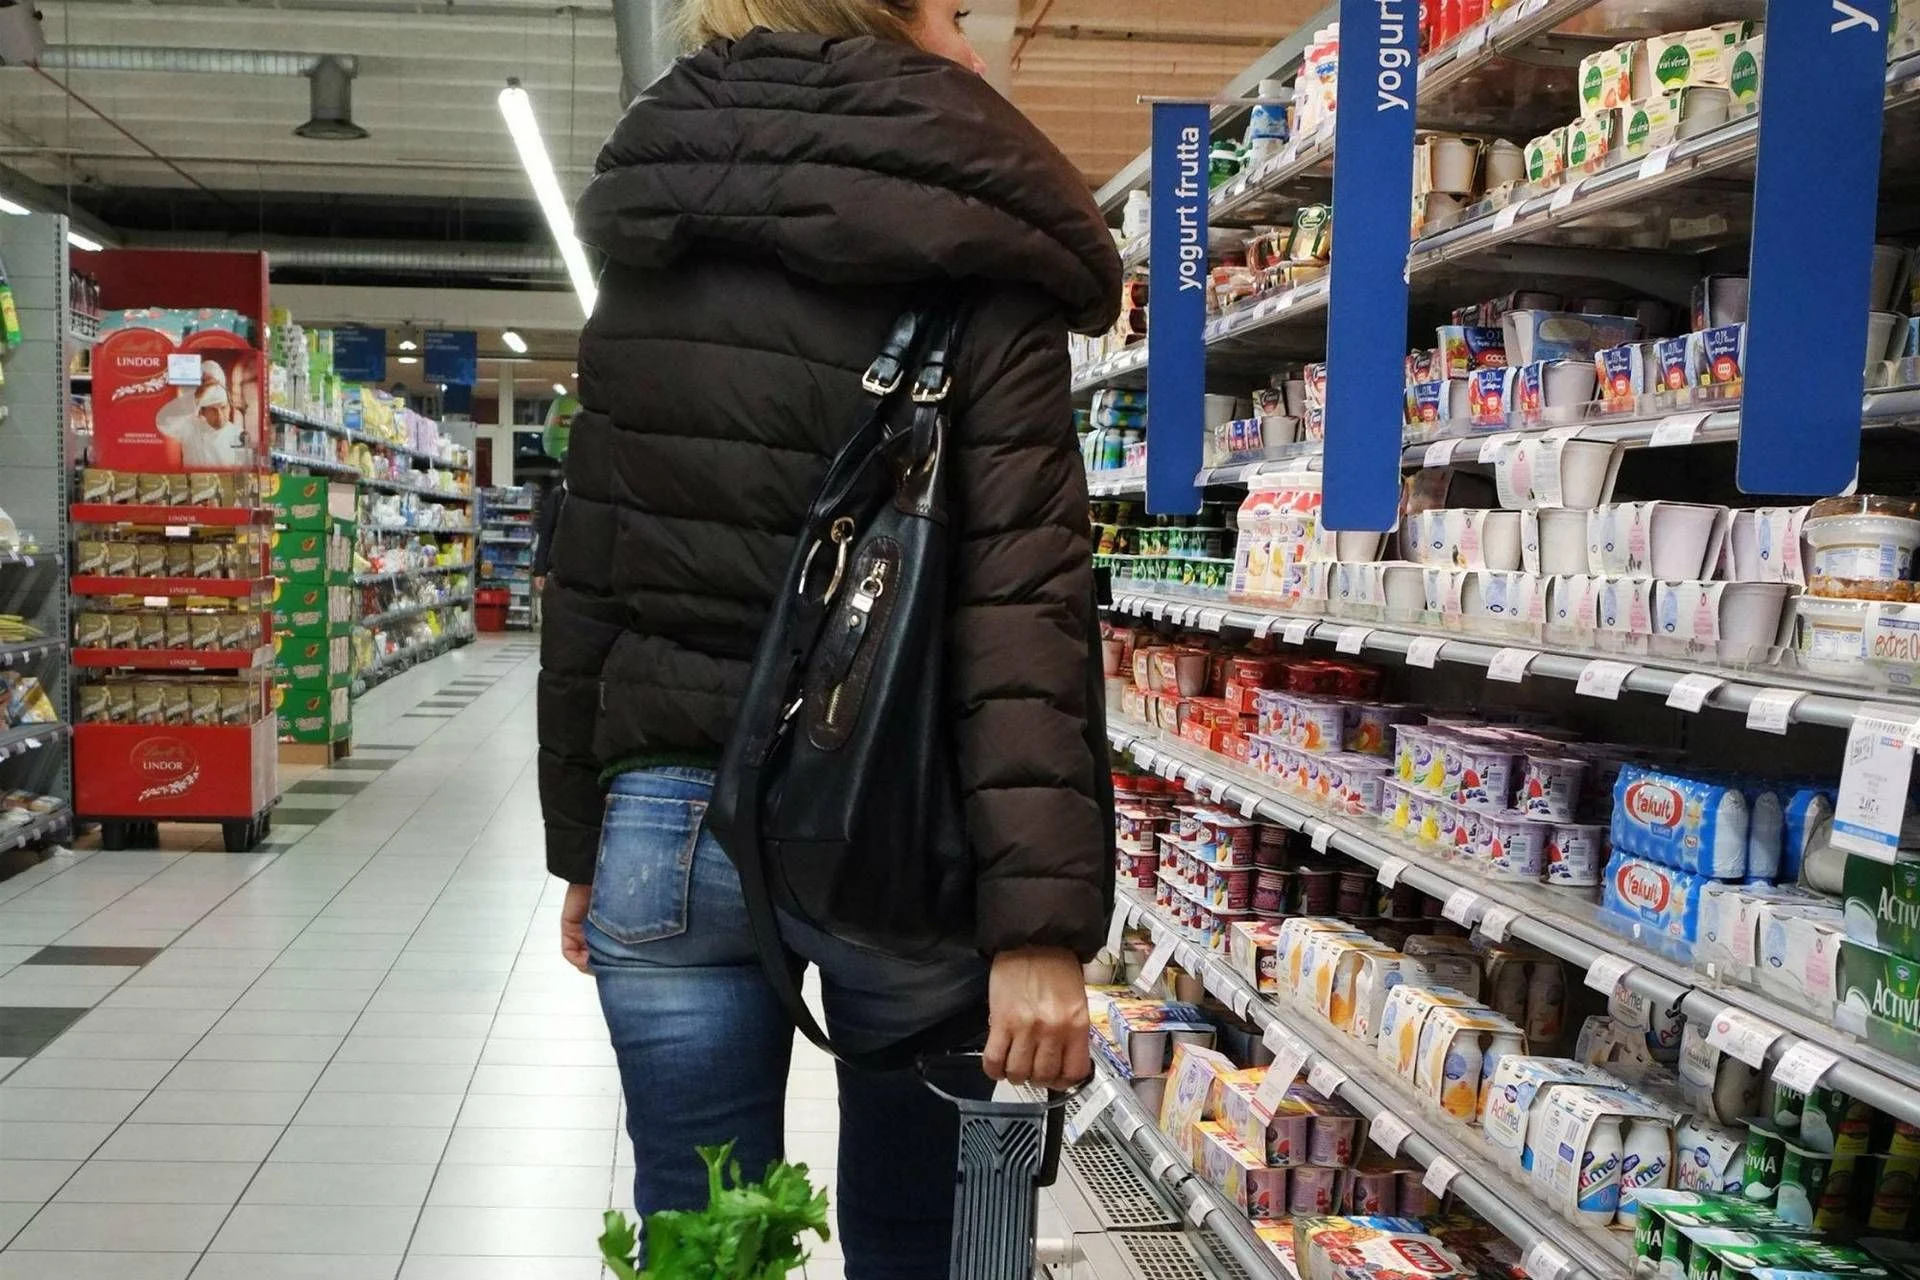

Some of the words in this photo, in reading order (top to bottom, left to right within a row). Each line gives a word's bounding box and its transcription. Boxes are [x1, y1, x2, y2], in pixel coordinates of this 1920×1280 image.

[1375, 0, 1410, 112] yogur
[1175, 127, 1200, 198] frutta
[1178, 210, 1203, 292] yogurt
[116, 356, 161, 368] LINDOR
[142, 761, 184, 771] LINDOR
[1636, 791, 1671, 820] Yakult
[1628, 873, 1659, 903] Yakult
[1877, 886, 1920, 930] ACTIV
[1872, 979, 1920, 1027] ACTIVI
[1490, 1098, 1521, 1134] Actimel
[1579, 1153, 1620, 1190] timel
[1620, 1156, 1667, 1196] ctimel
